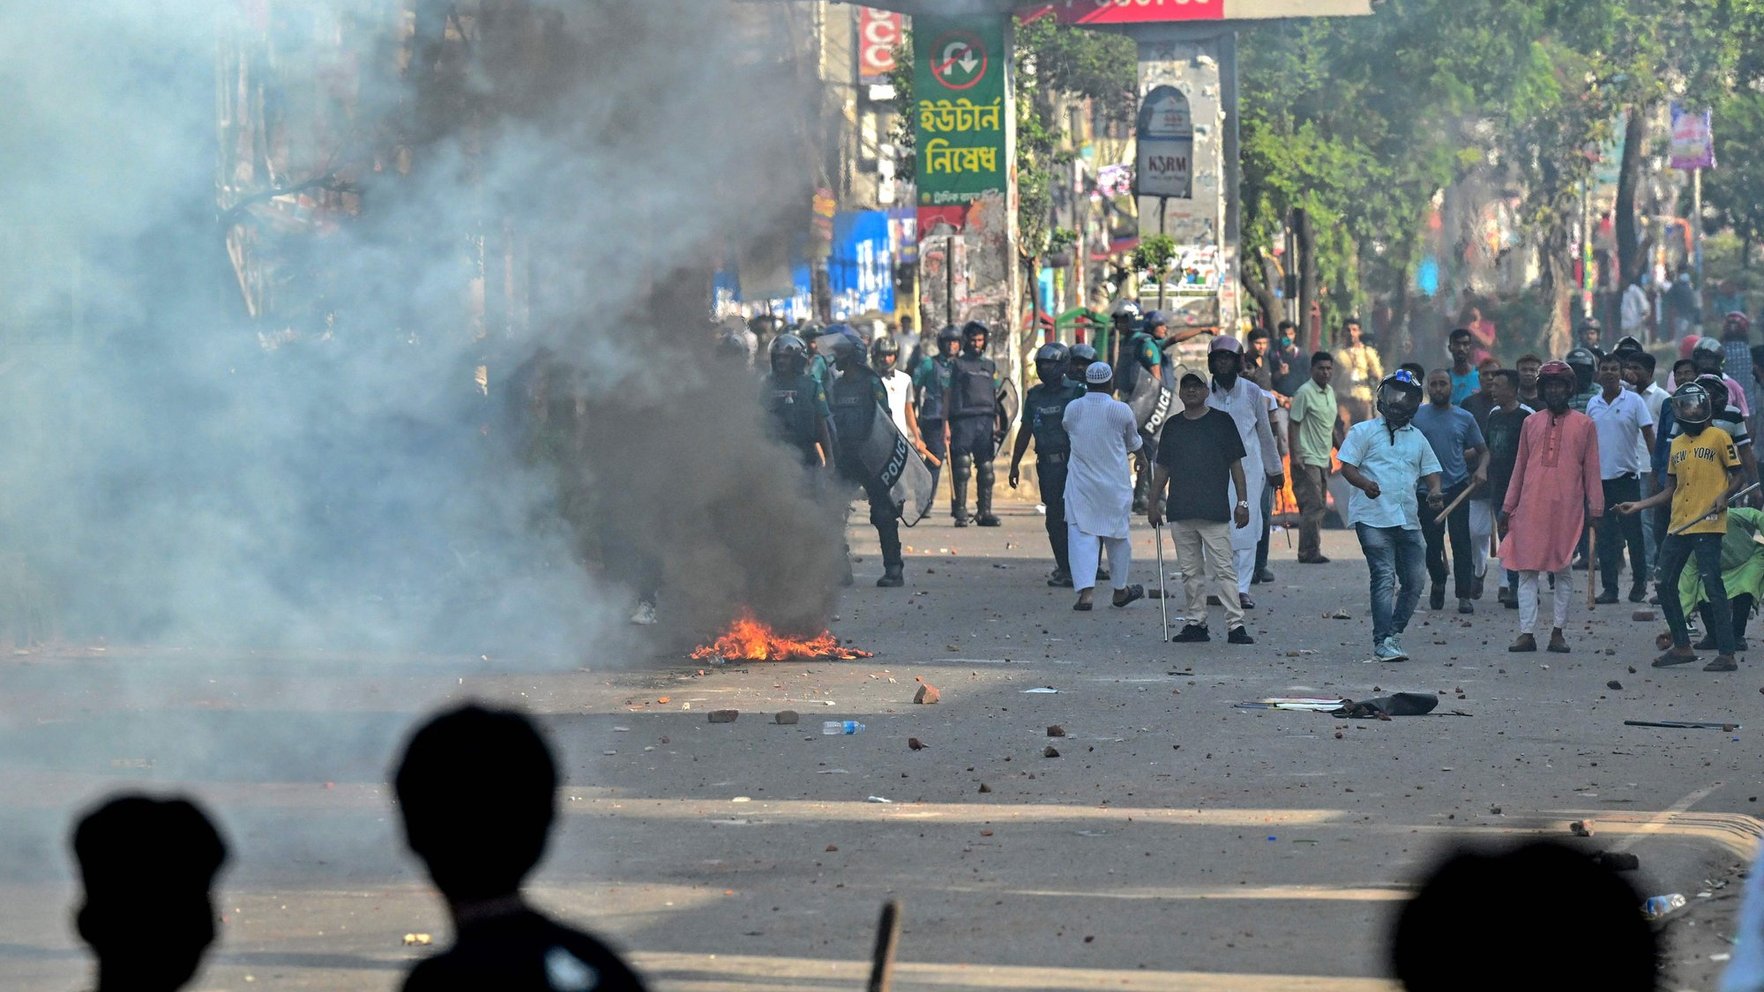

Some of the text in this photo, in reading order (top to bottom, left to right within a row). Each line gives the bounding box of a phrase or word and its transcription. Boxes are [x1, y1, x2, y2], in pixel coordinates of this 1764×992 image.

[919, 96, 1001, 132] ইউটার্ন
[925, 138, 997, 174] নিষেধ
[1148, 155, 1187, 174] KSRM
[1145, 386, 1171, 434] POLICE
[1693, 447, 1716, 462] YORK
